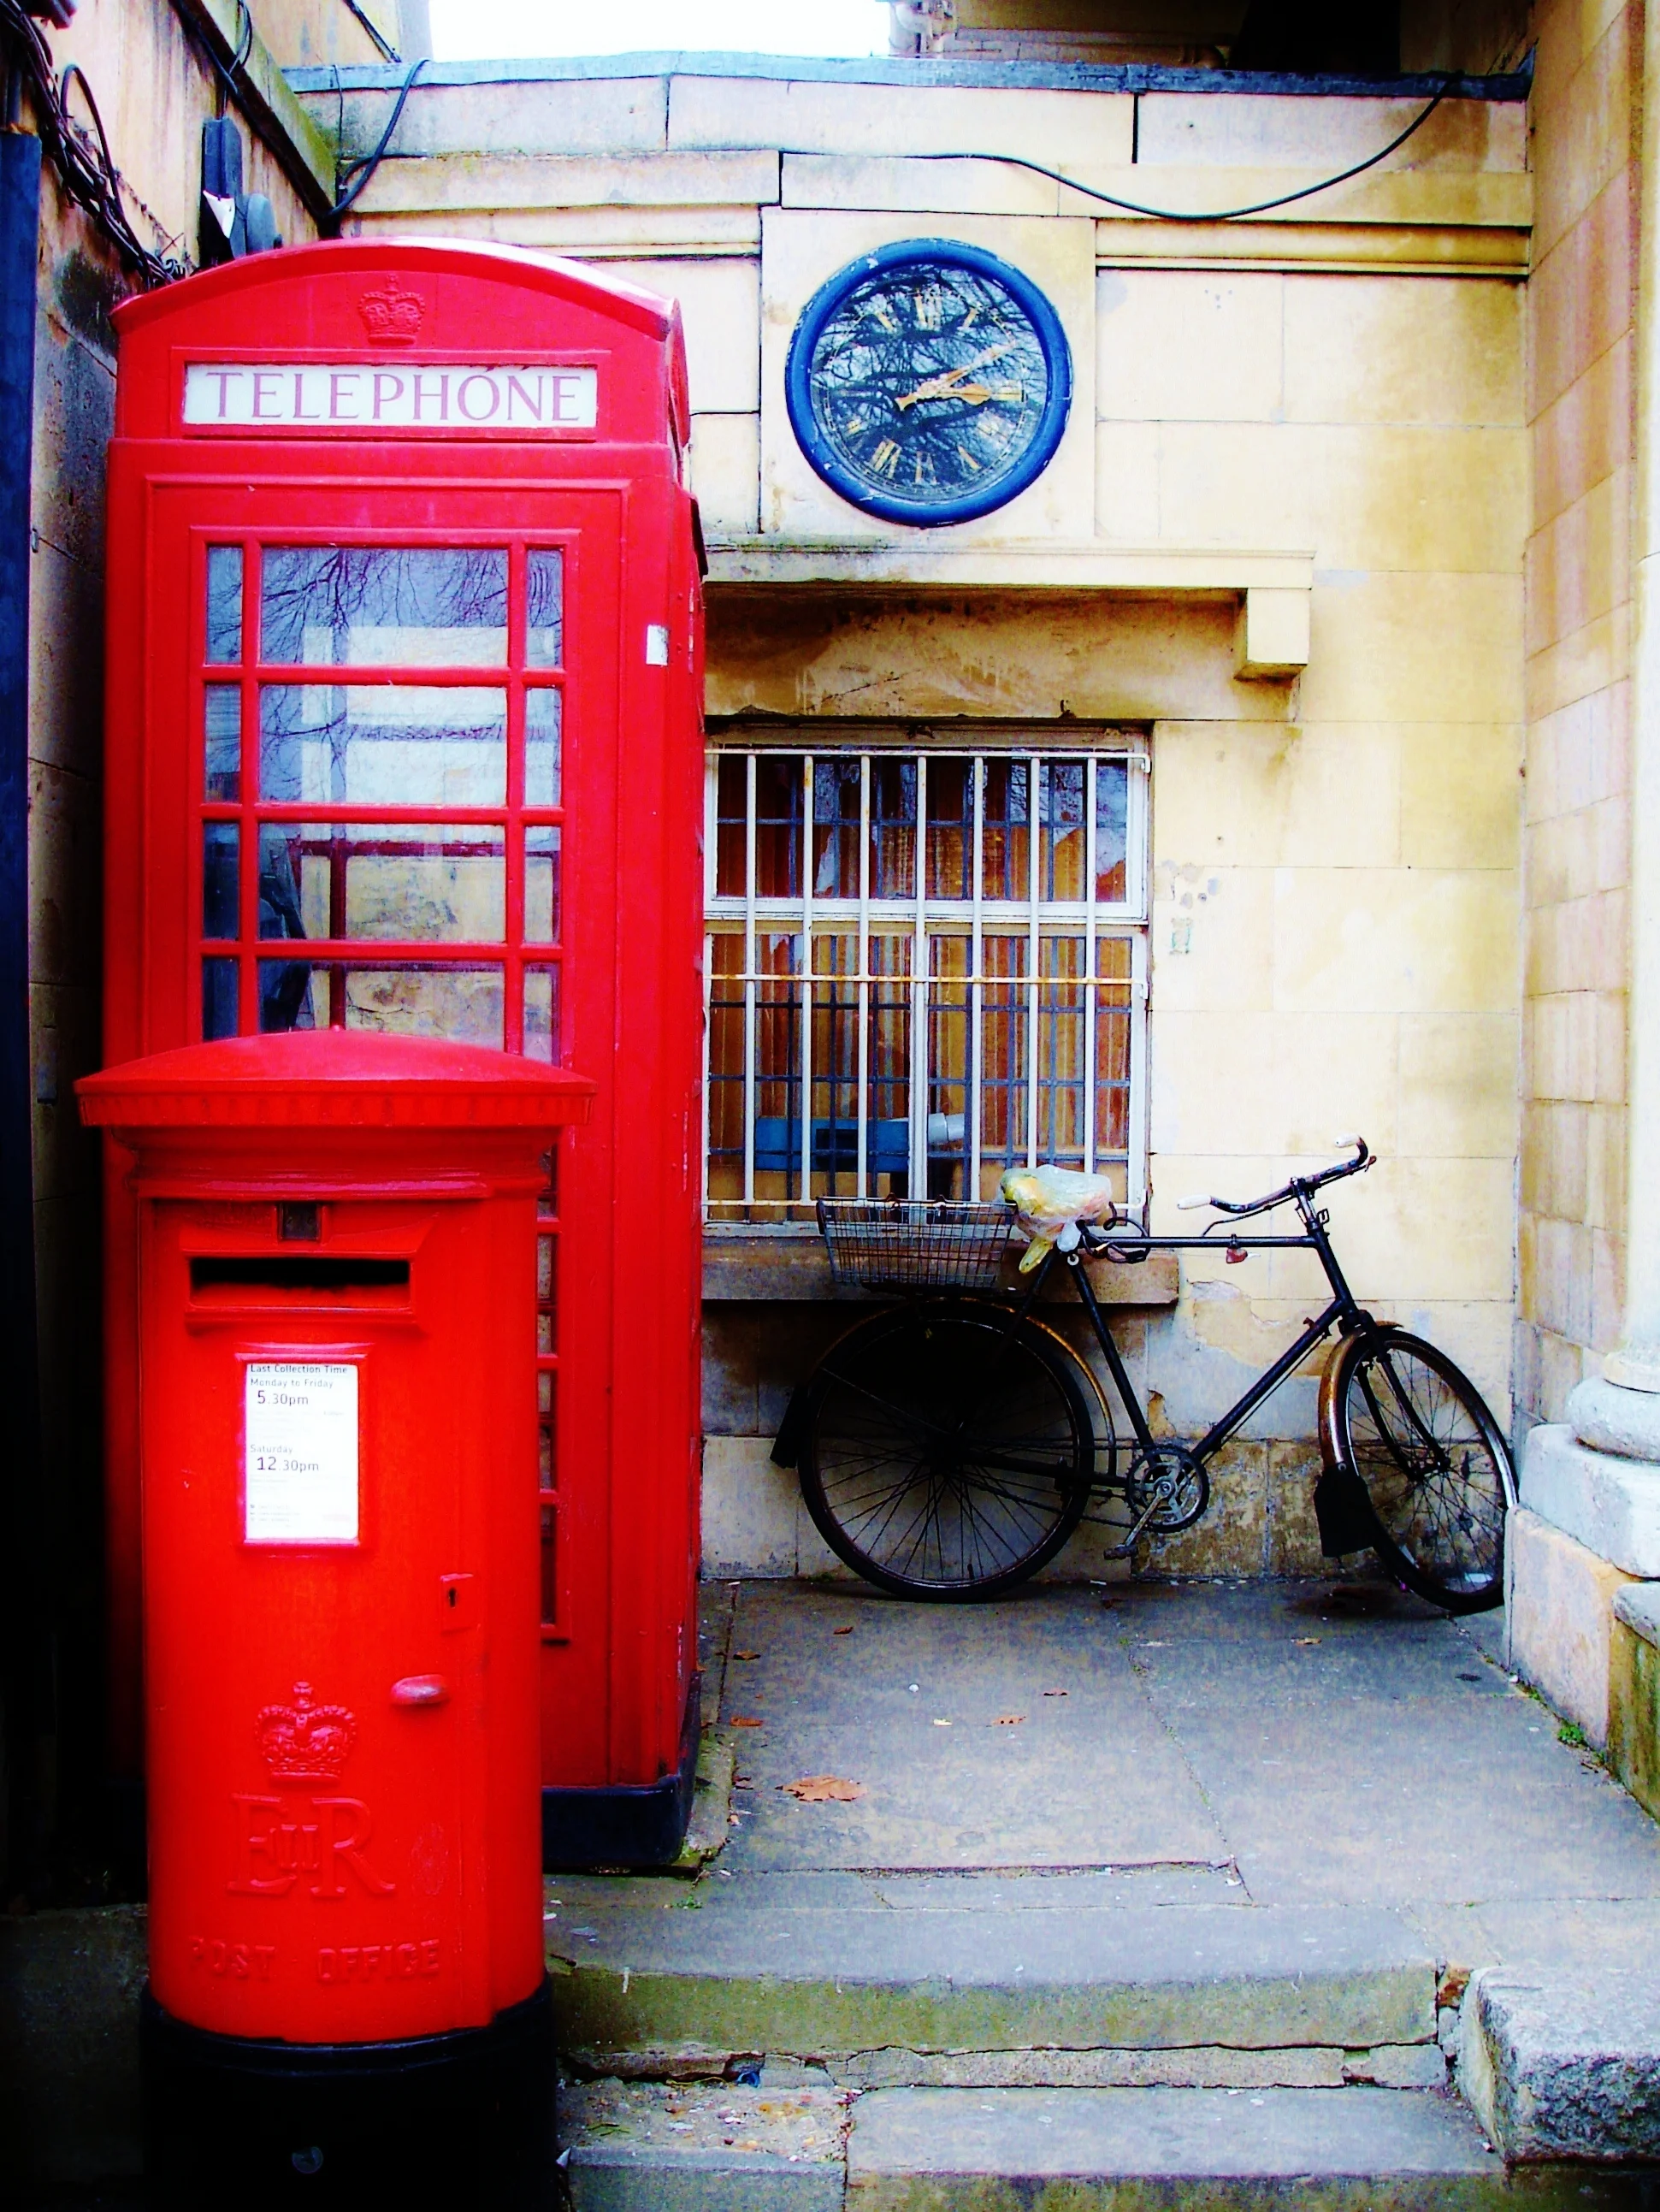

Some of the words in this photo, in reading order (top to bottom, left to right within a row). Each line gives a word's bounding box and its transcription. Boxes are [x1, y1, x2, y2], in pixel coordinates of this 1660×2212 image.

[206, 370, 582, 423] TELEPHONE
[251, 1363, 271, 1374] Last
[275, 1363, 321, 1374] Collection
[324, 1364, 347, 1375] Time
[251, 1378, 287, 1388] Monday
[291, 1379, 301, 1387] to
[304, 1378, 334, 1389] Friday
[257, 1390, 309, 1407] 5.30pm
[250, 1444, 293, 1455] Saturday
[257, 1456, 320, 1473] 12.30pm
[187, 1935, 276, 1980] POST
[316, 1938, 440, 1984] OFFICE
